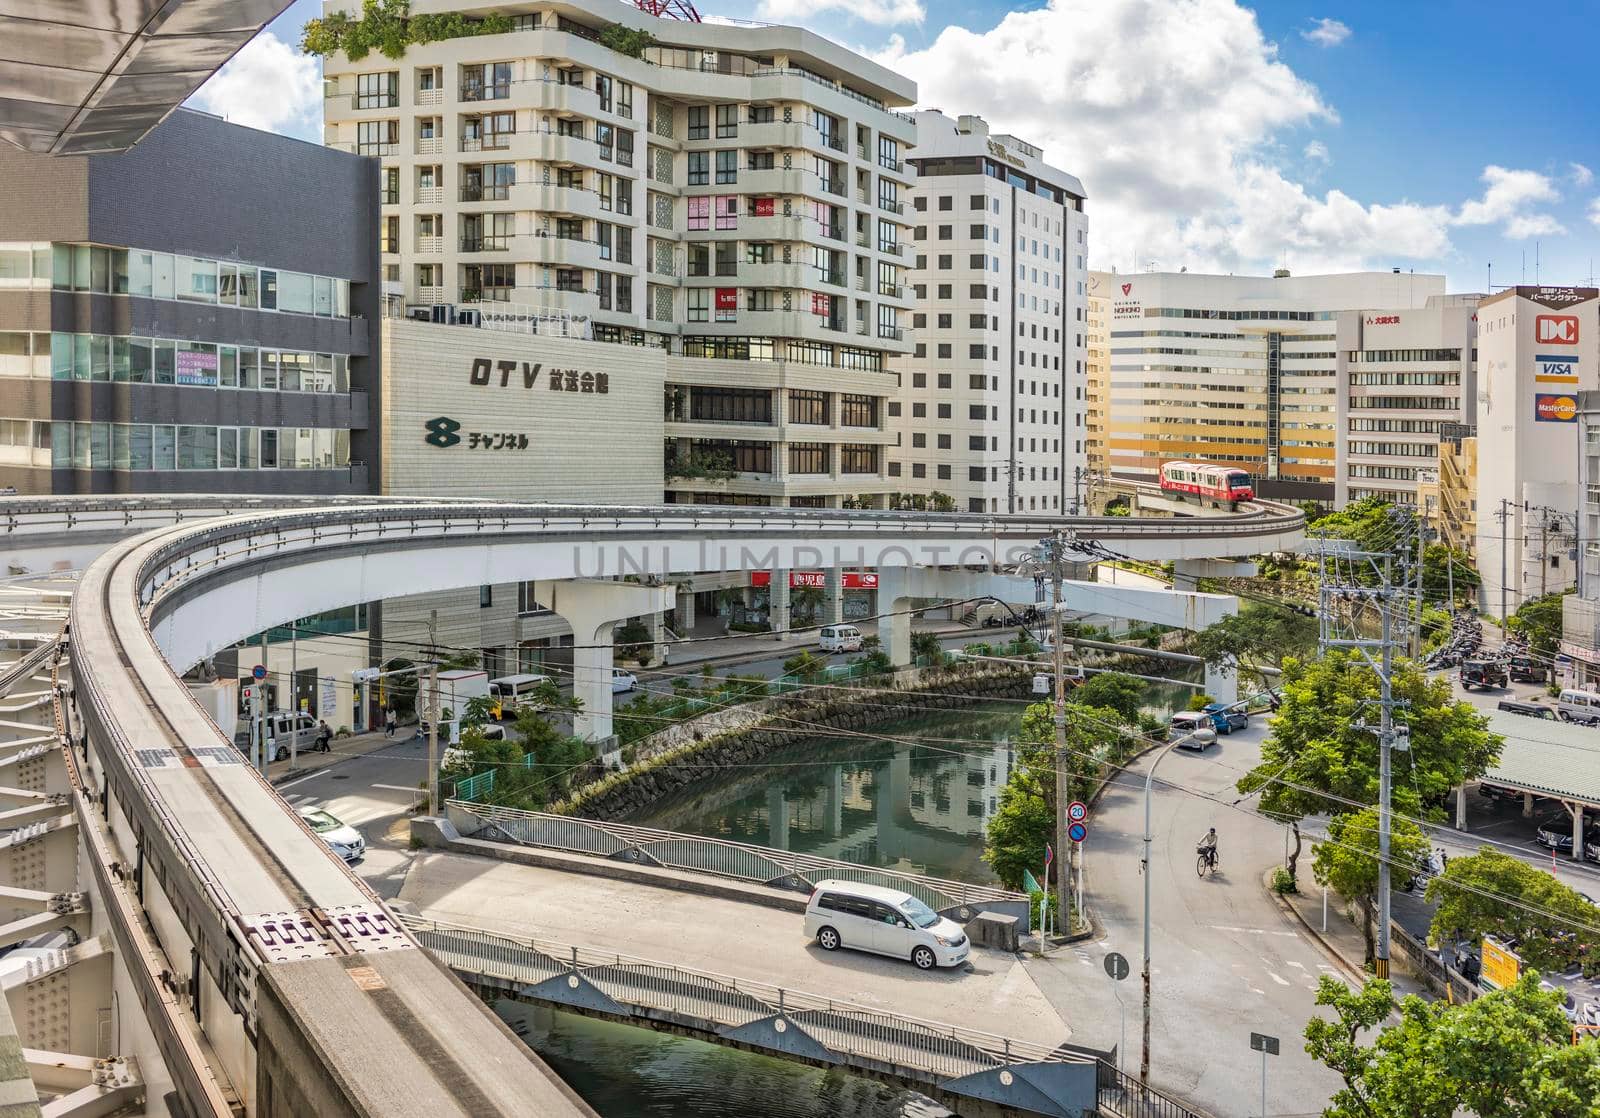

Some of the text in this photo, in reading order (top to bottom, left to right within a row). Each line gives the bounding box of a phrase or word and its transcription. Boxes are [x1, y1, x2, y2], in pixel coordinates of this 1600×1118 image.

[1540, 319, 1575, 341] DC
[1543, 363, 1572, 375] VISA
[469, 432, 529, 450] チャンネル
[794, 574, 848, 587] 鹿児島行
[1072, 807, 1083, 817] 20
